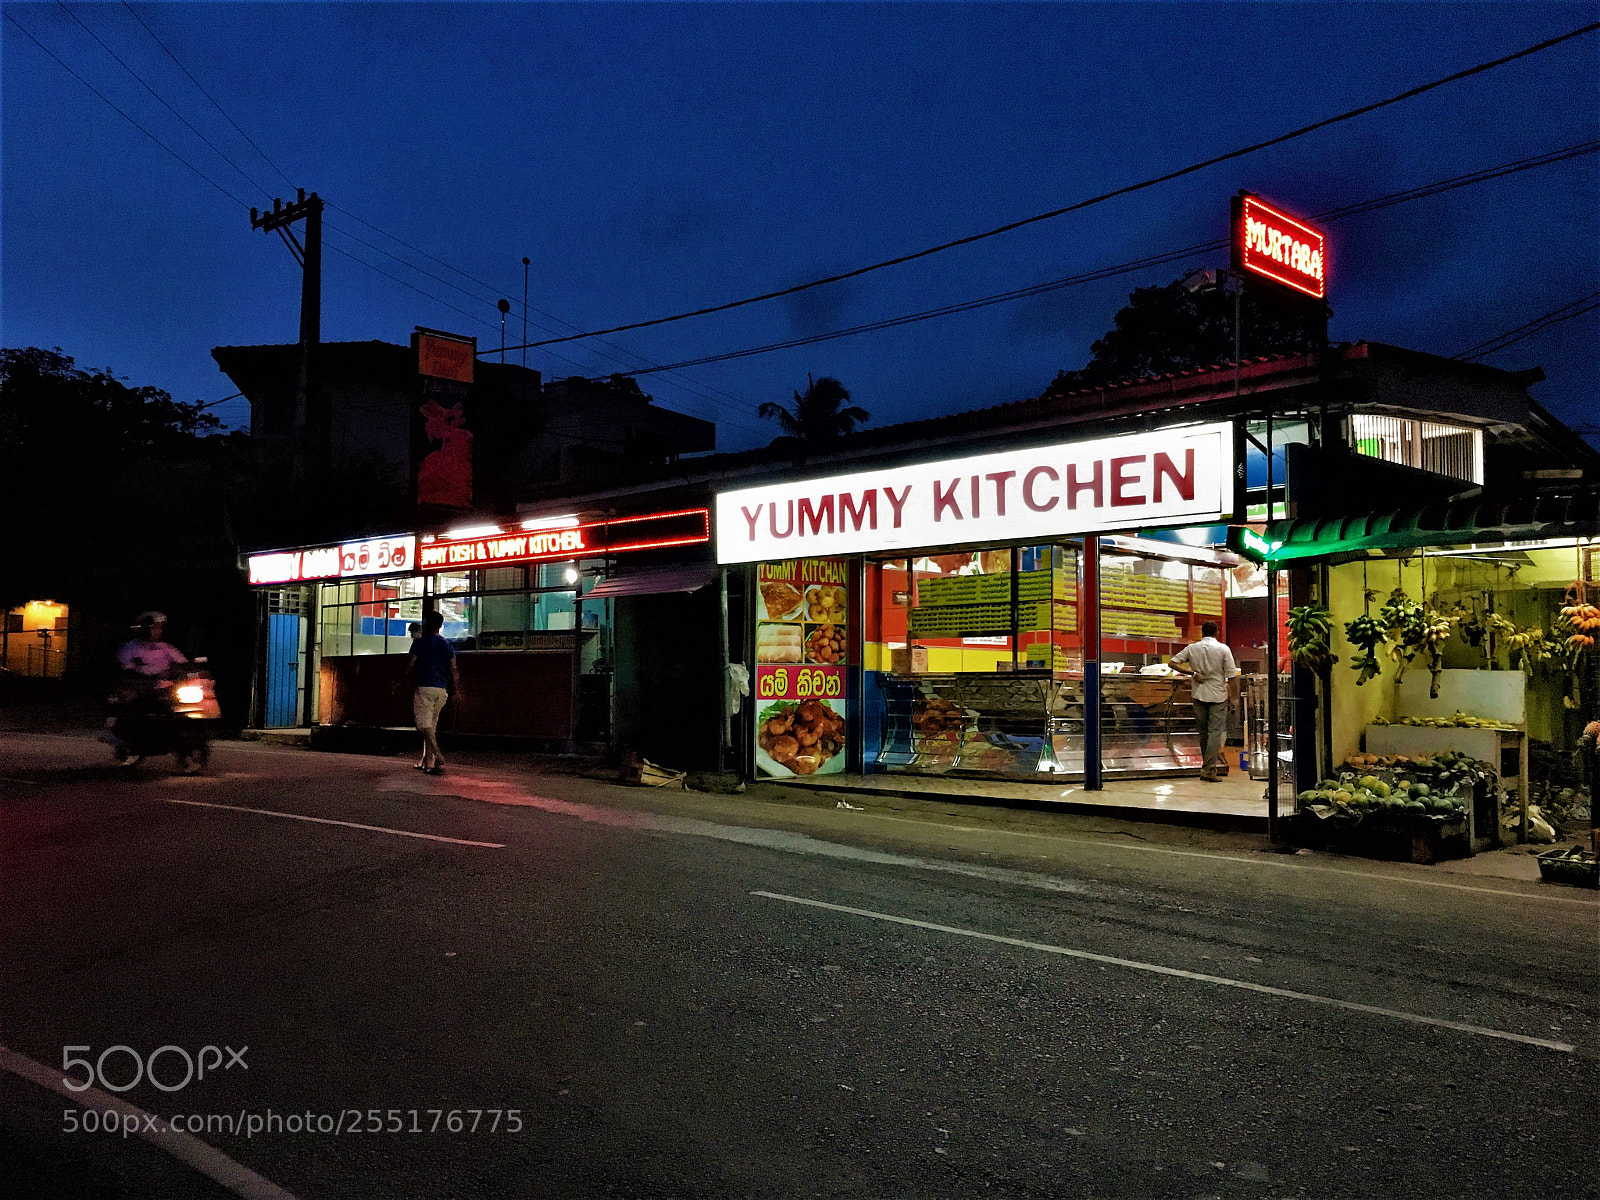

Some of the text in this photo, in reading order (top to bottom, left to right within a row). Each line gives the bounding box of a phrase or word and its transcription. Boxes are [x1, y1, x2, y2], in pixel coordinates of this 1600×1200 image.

[1246, 217, 1322, 279] MURTABA
[741, 448, 1195, 542] YUMMY KITCHEN
[449, 544, 474, 562] DISH
[477, 543, 487, 560] &
[488, 537, 527, 558] YUMMY
[760, 560, 846, 583] YUMMY KITCHAN
